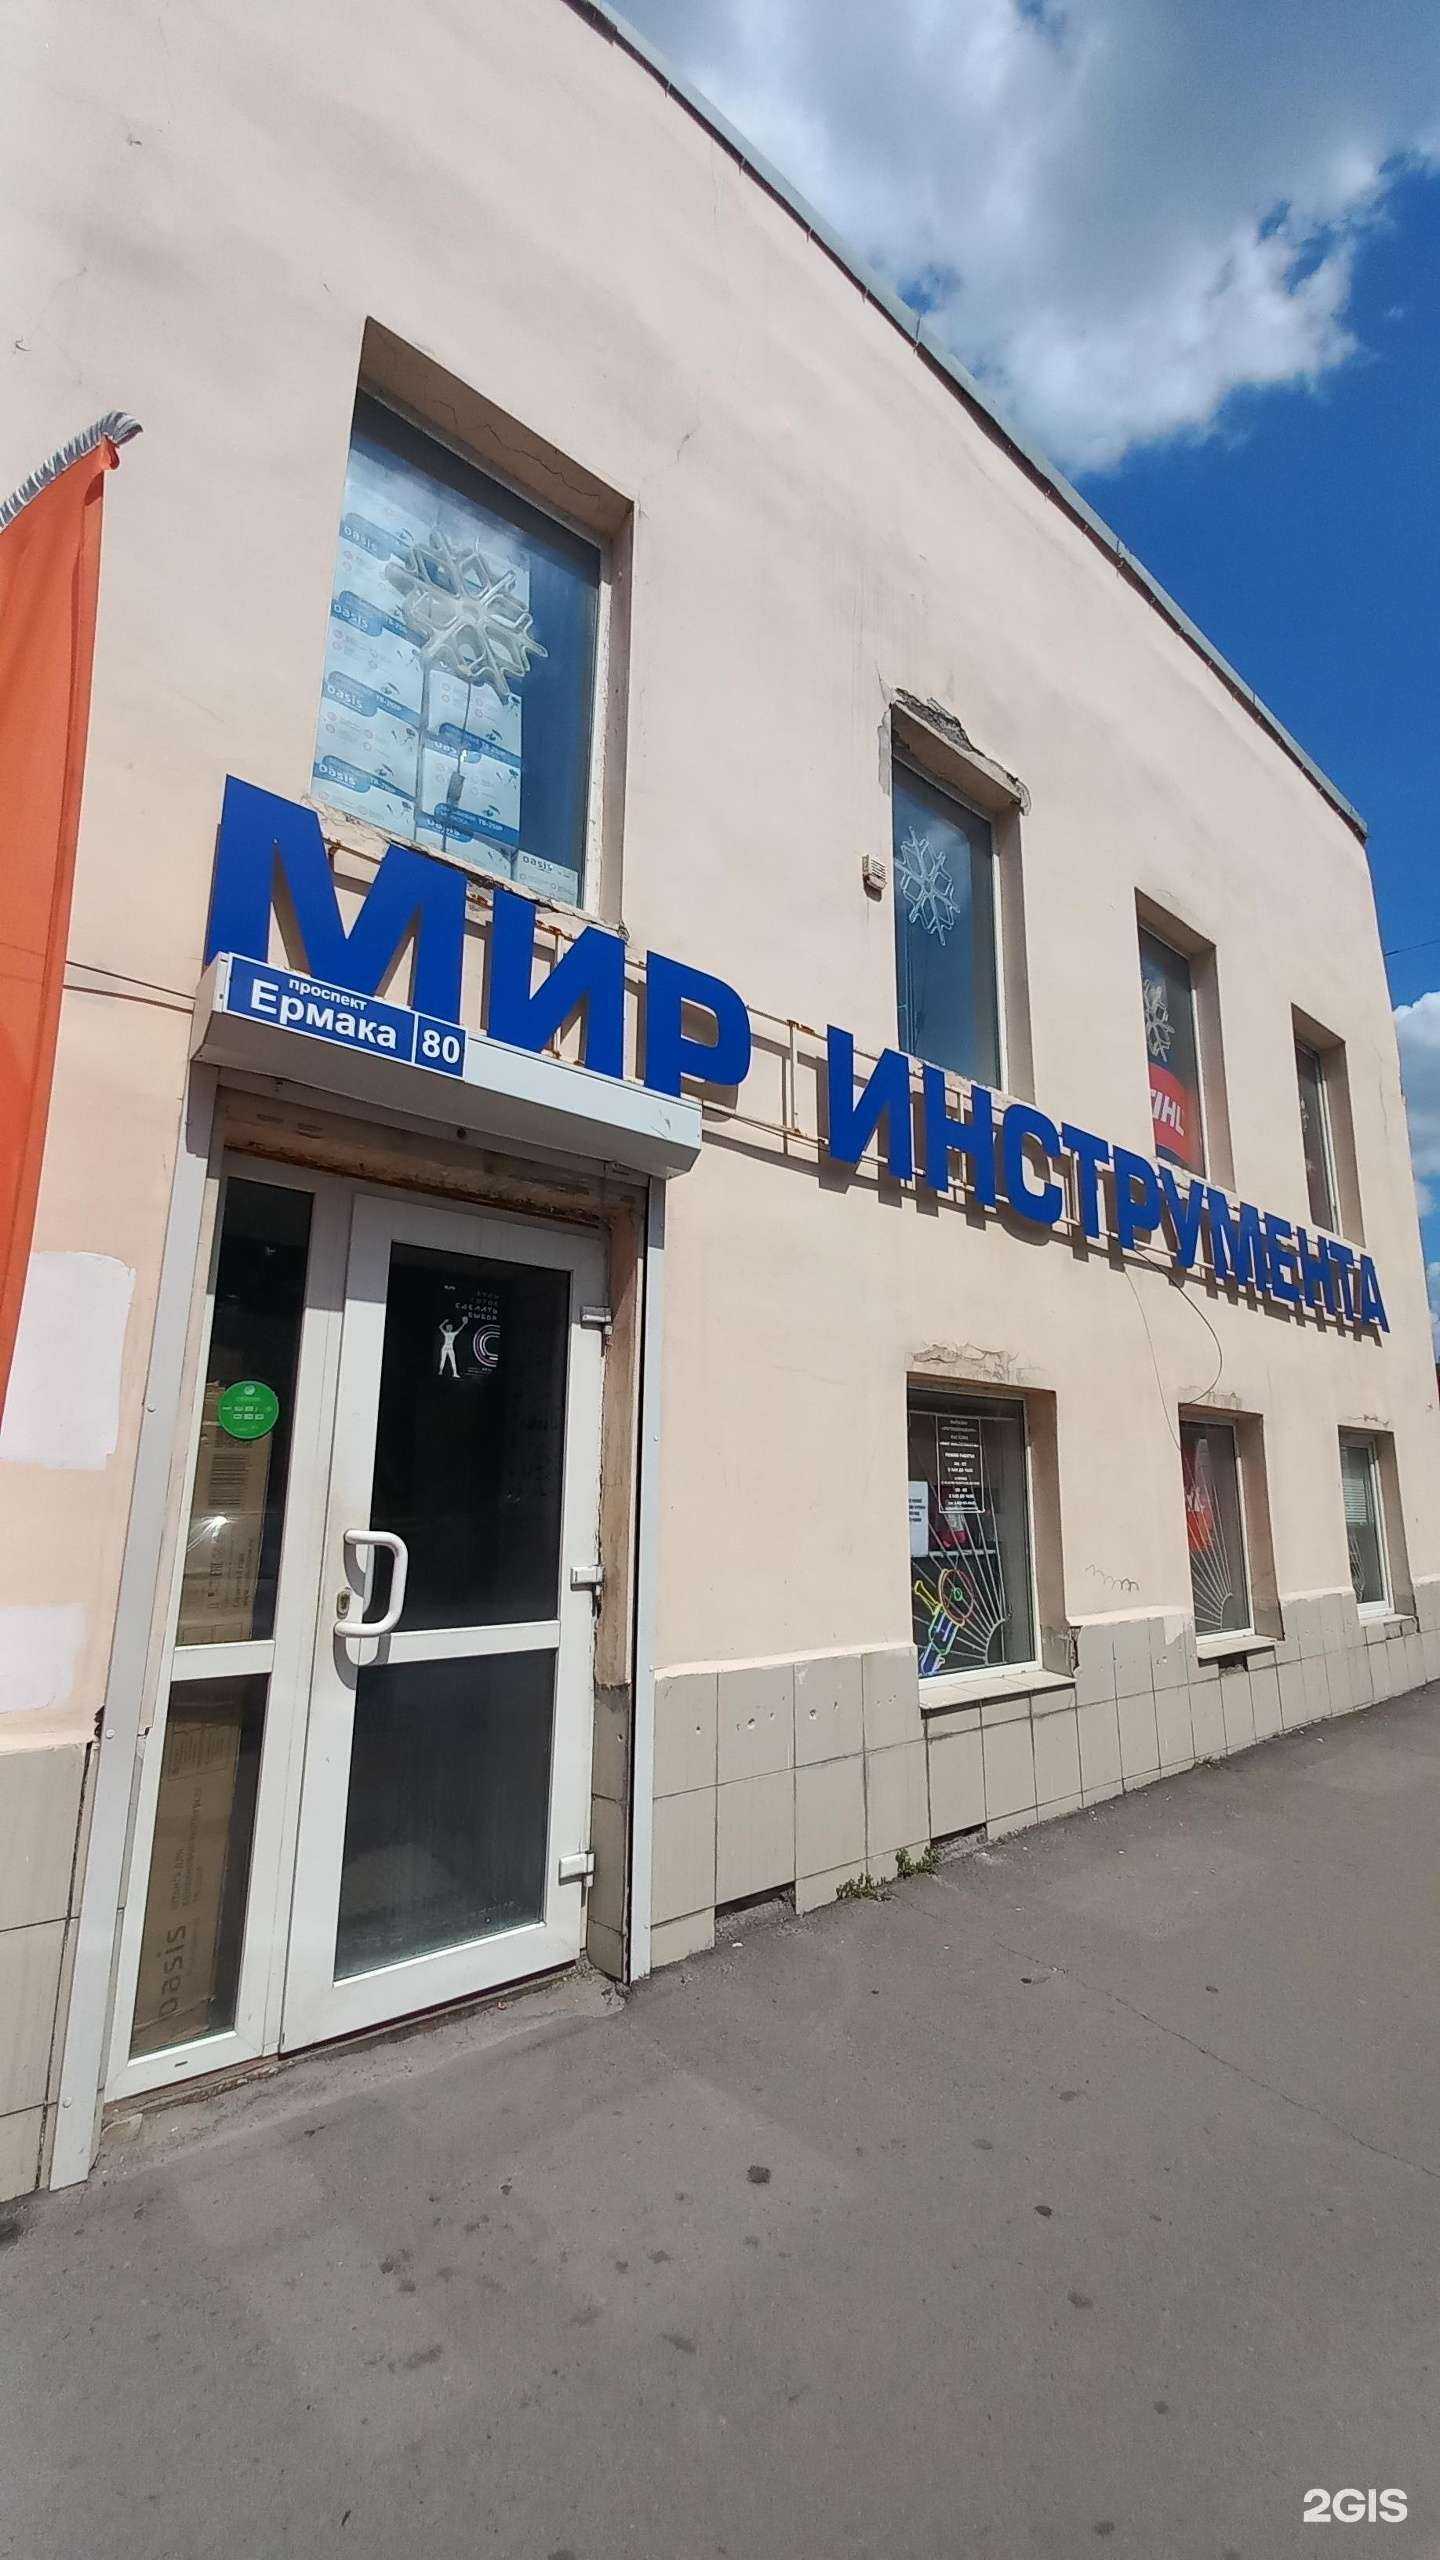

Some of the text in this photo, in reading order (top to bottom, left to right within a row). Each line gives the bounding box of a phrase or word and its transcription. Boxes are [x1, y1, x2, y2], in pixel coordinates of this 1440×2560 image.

[319, 763, 357, 787] oasis
[522, 854, 554, 872] oasis
[288, 977, 368, 1012] проспект
[250, 978, 398, 1051] Ермака
[203, 773, 1391, 1334] МИР ИНСТРУМЕНТА
[421, 1029, 461, 1065] 80
[157, 1924, 186, 2018] oasis
